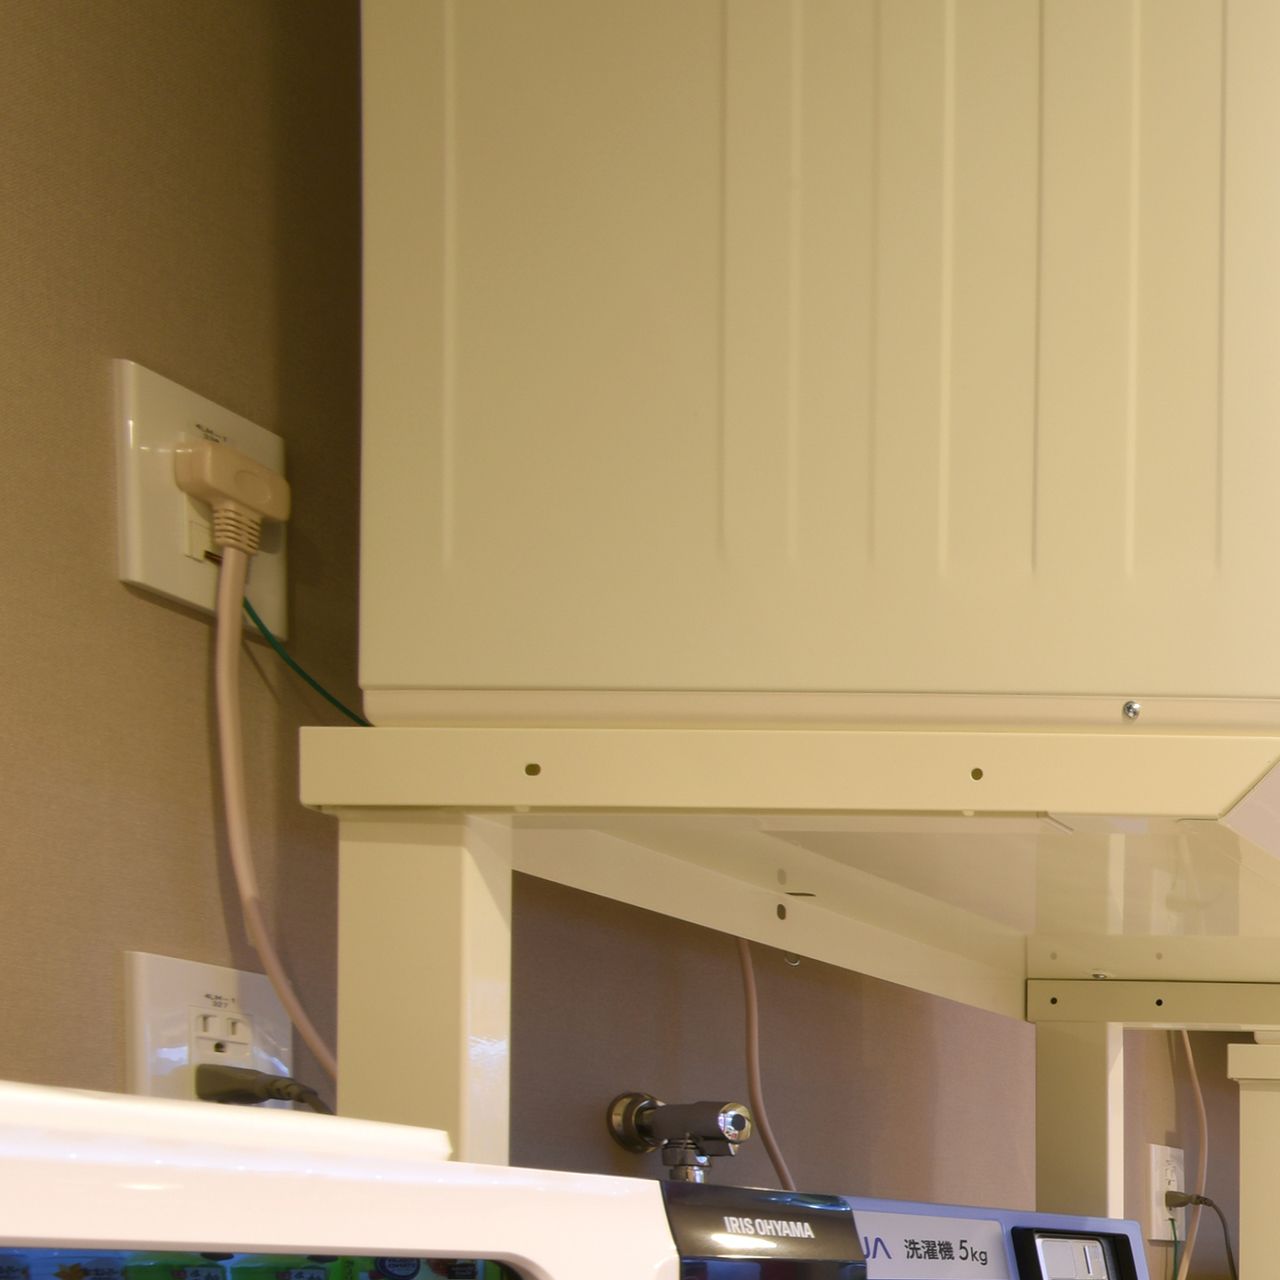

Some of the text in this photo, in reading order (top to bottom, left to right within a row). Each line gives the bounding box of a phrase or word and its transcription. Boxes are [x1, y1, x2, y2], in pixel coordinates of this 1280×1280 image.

[723, 1216, 816, 1239] IRIS OHYAMA
[904, 1238, 956, 1262] 洗濯機
[958, 1238, 989, 1266] 5kg
